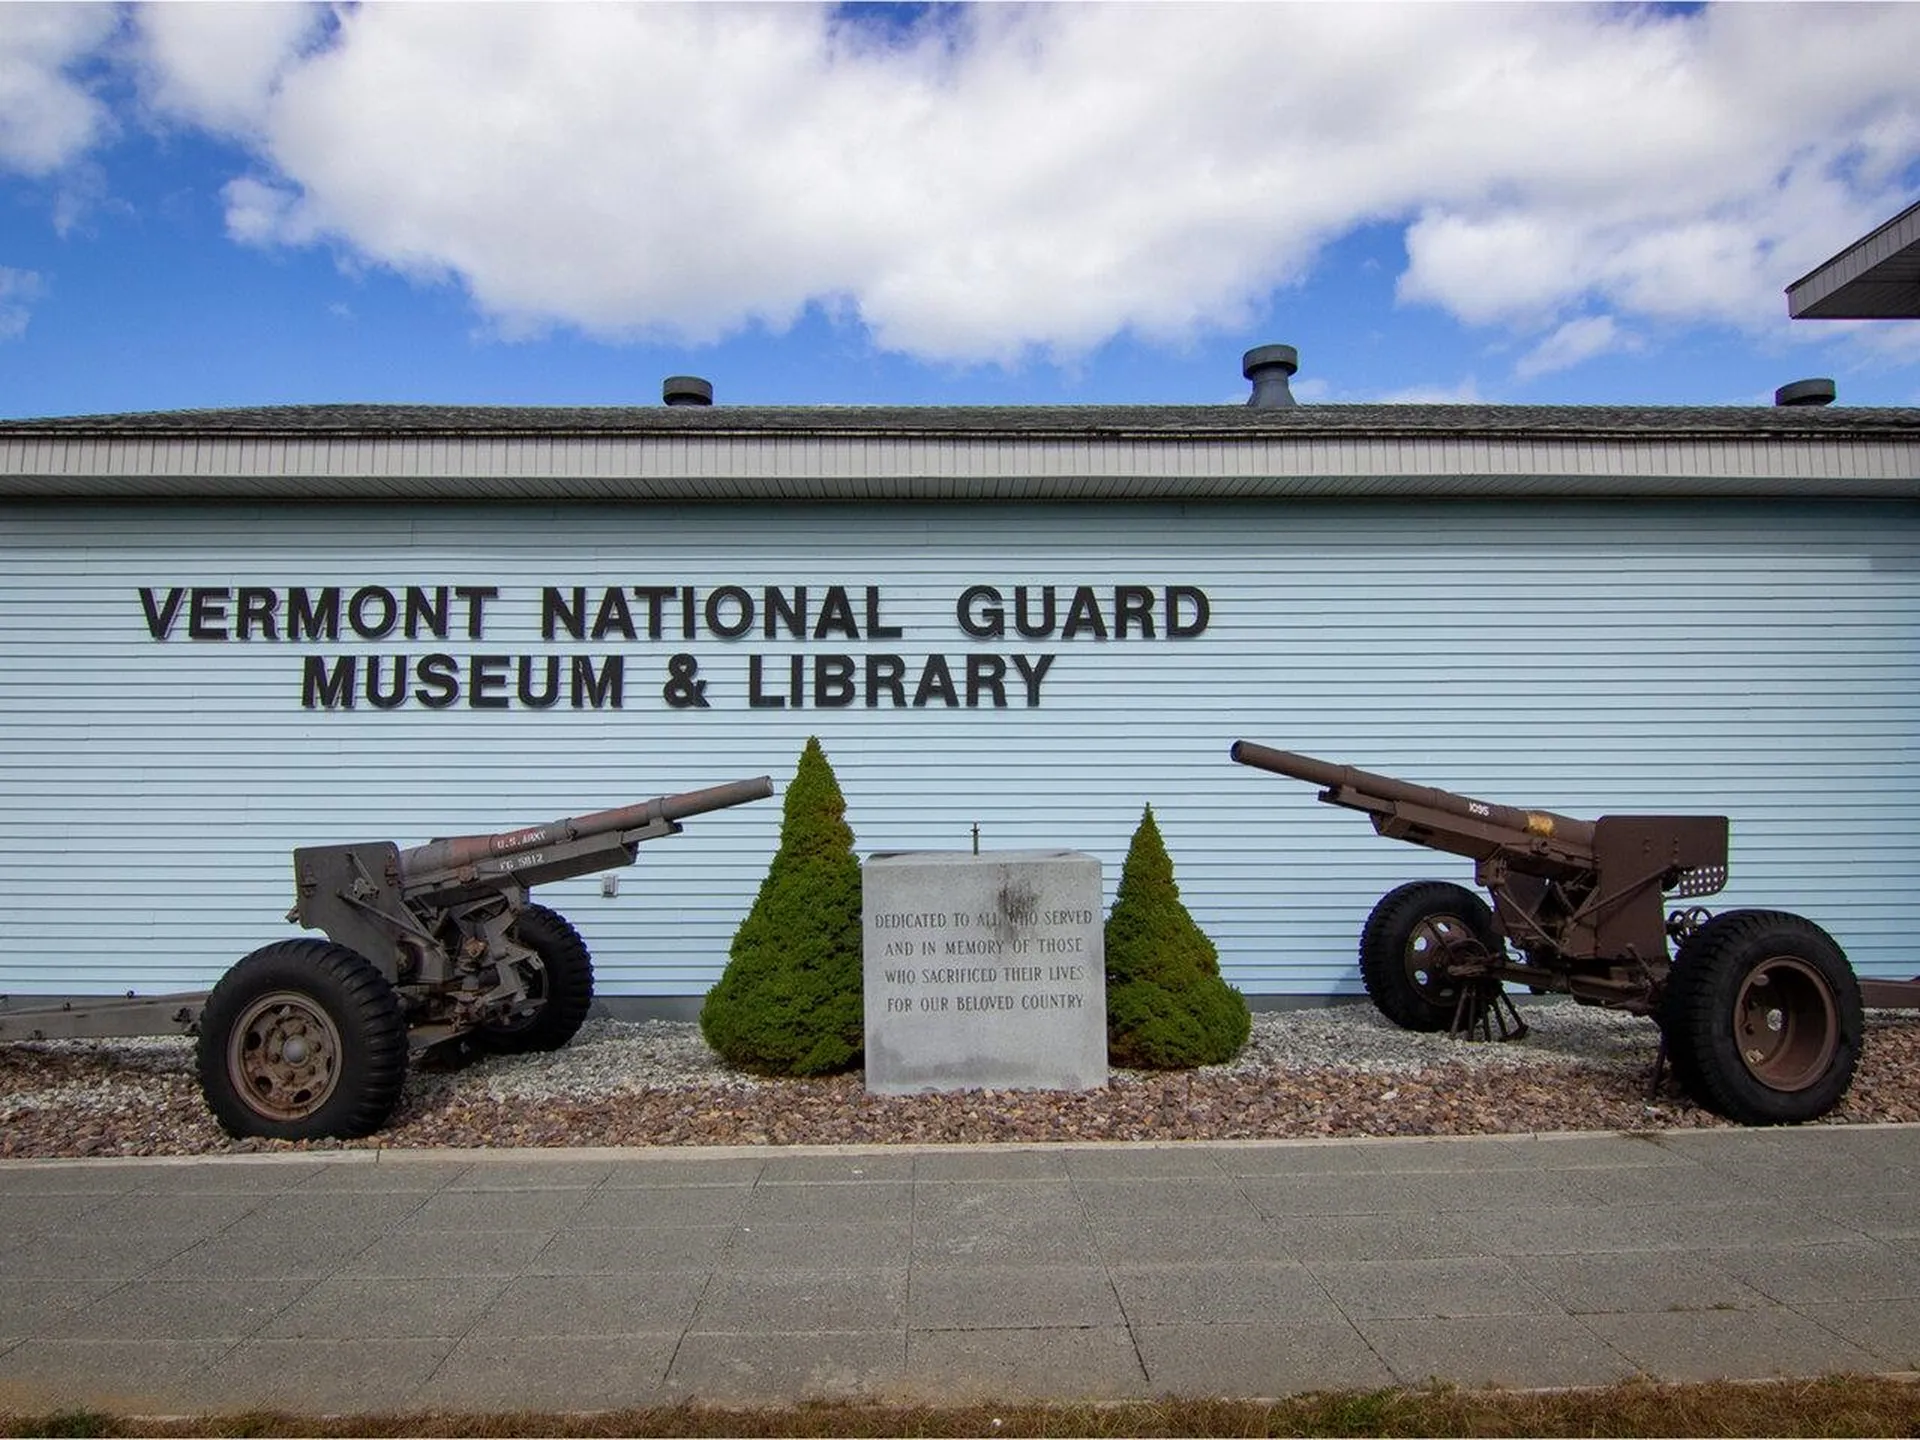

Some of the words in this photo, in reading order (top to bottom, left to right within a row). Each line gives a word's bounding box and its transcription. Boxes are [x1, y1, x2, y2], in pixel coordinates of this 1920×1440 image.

[138, 585, 498, 641] VERMONT
[542, 585, 902, 641] NATIONAL
[956, 584, 1210, 640] GUARD
[302, 653, 624, 710] MUSEUM
[663, 653, 710, 708] &
[749, 653, 1056, 709] LIBRARY
[875, 912, 947, 929] DEDICATED
[953, 912, 970, 928] TO
[976, 912, 998, 927] ALL
[1007, 911, 1038, 926] WHO
[1044, 910, 1093, 926] SERVED
[884, 941, 914, 957] AND
[922, 940, 936, 956] IN
[945, 939, 1003, 955] MEMORY
[1012, 938, 1031, 954] OF
[1036, 937, 1084, 953] THOSE
[884, 970, 916, 985] WHO
[922, 968, 998, 984] SACRIFICED
[1004, 967, 1043, 982] THEIR
[1049, 965, 1085, 981] LIVES
[887, 998, 913, 1013] FOR
[920, 997, 949, 1012] OUR
[957, 996, 1015, 1011] BELOVED
[1021, 994, 1085, 1010] COUNTRY
